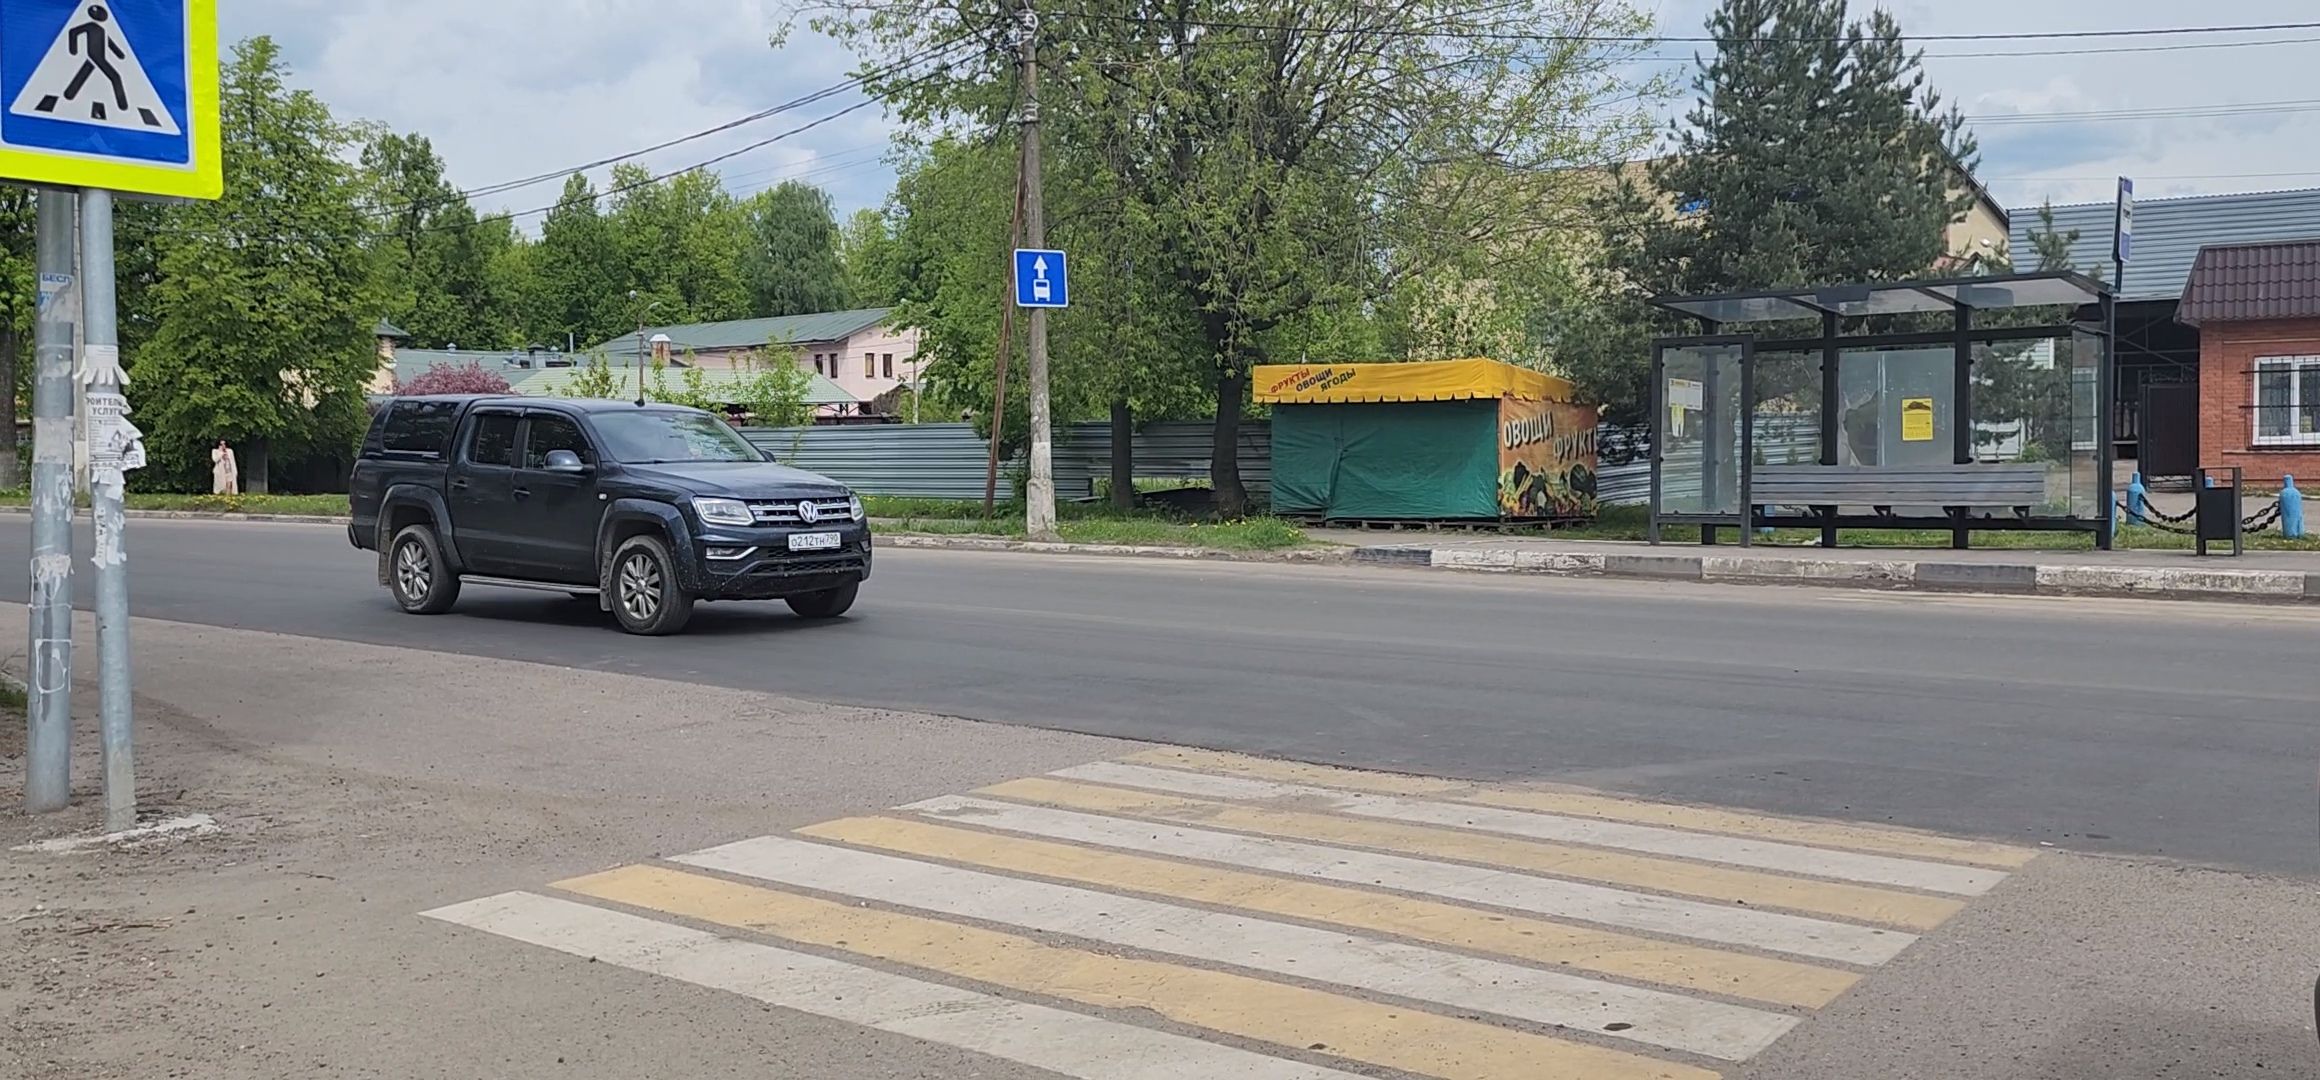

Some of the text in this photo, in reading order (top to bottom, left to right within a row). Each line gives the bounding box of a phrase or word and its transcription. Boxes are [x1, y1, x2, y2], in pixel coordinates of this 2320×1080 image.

[1270, 368, 1311, 393] ФРУКТЫ
[1295, 368, 1333, 392] ОВОЩИ
[1320, 368, 1356, 392] ЯГОДЫ
[1504, 411, 1553, 450] ОВОЩИ
